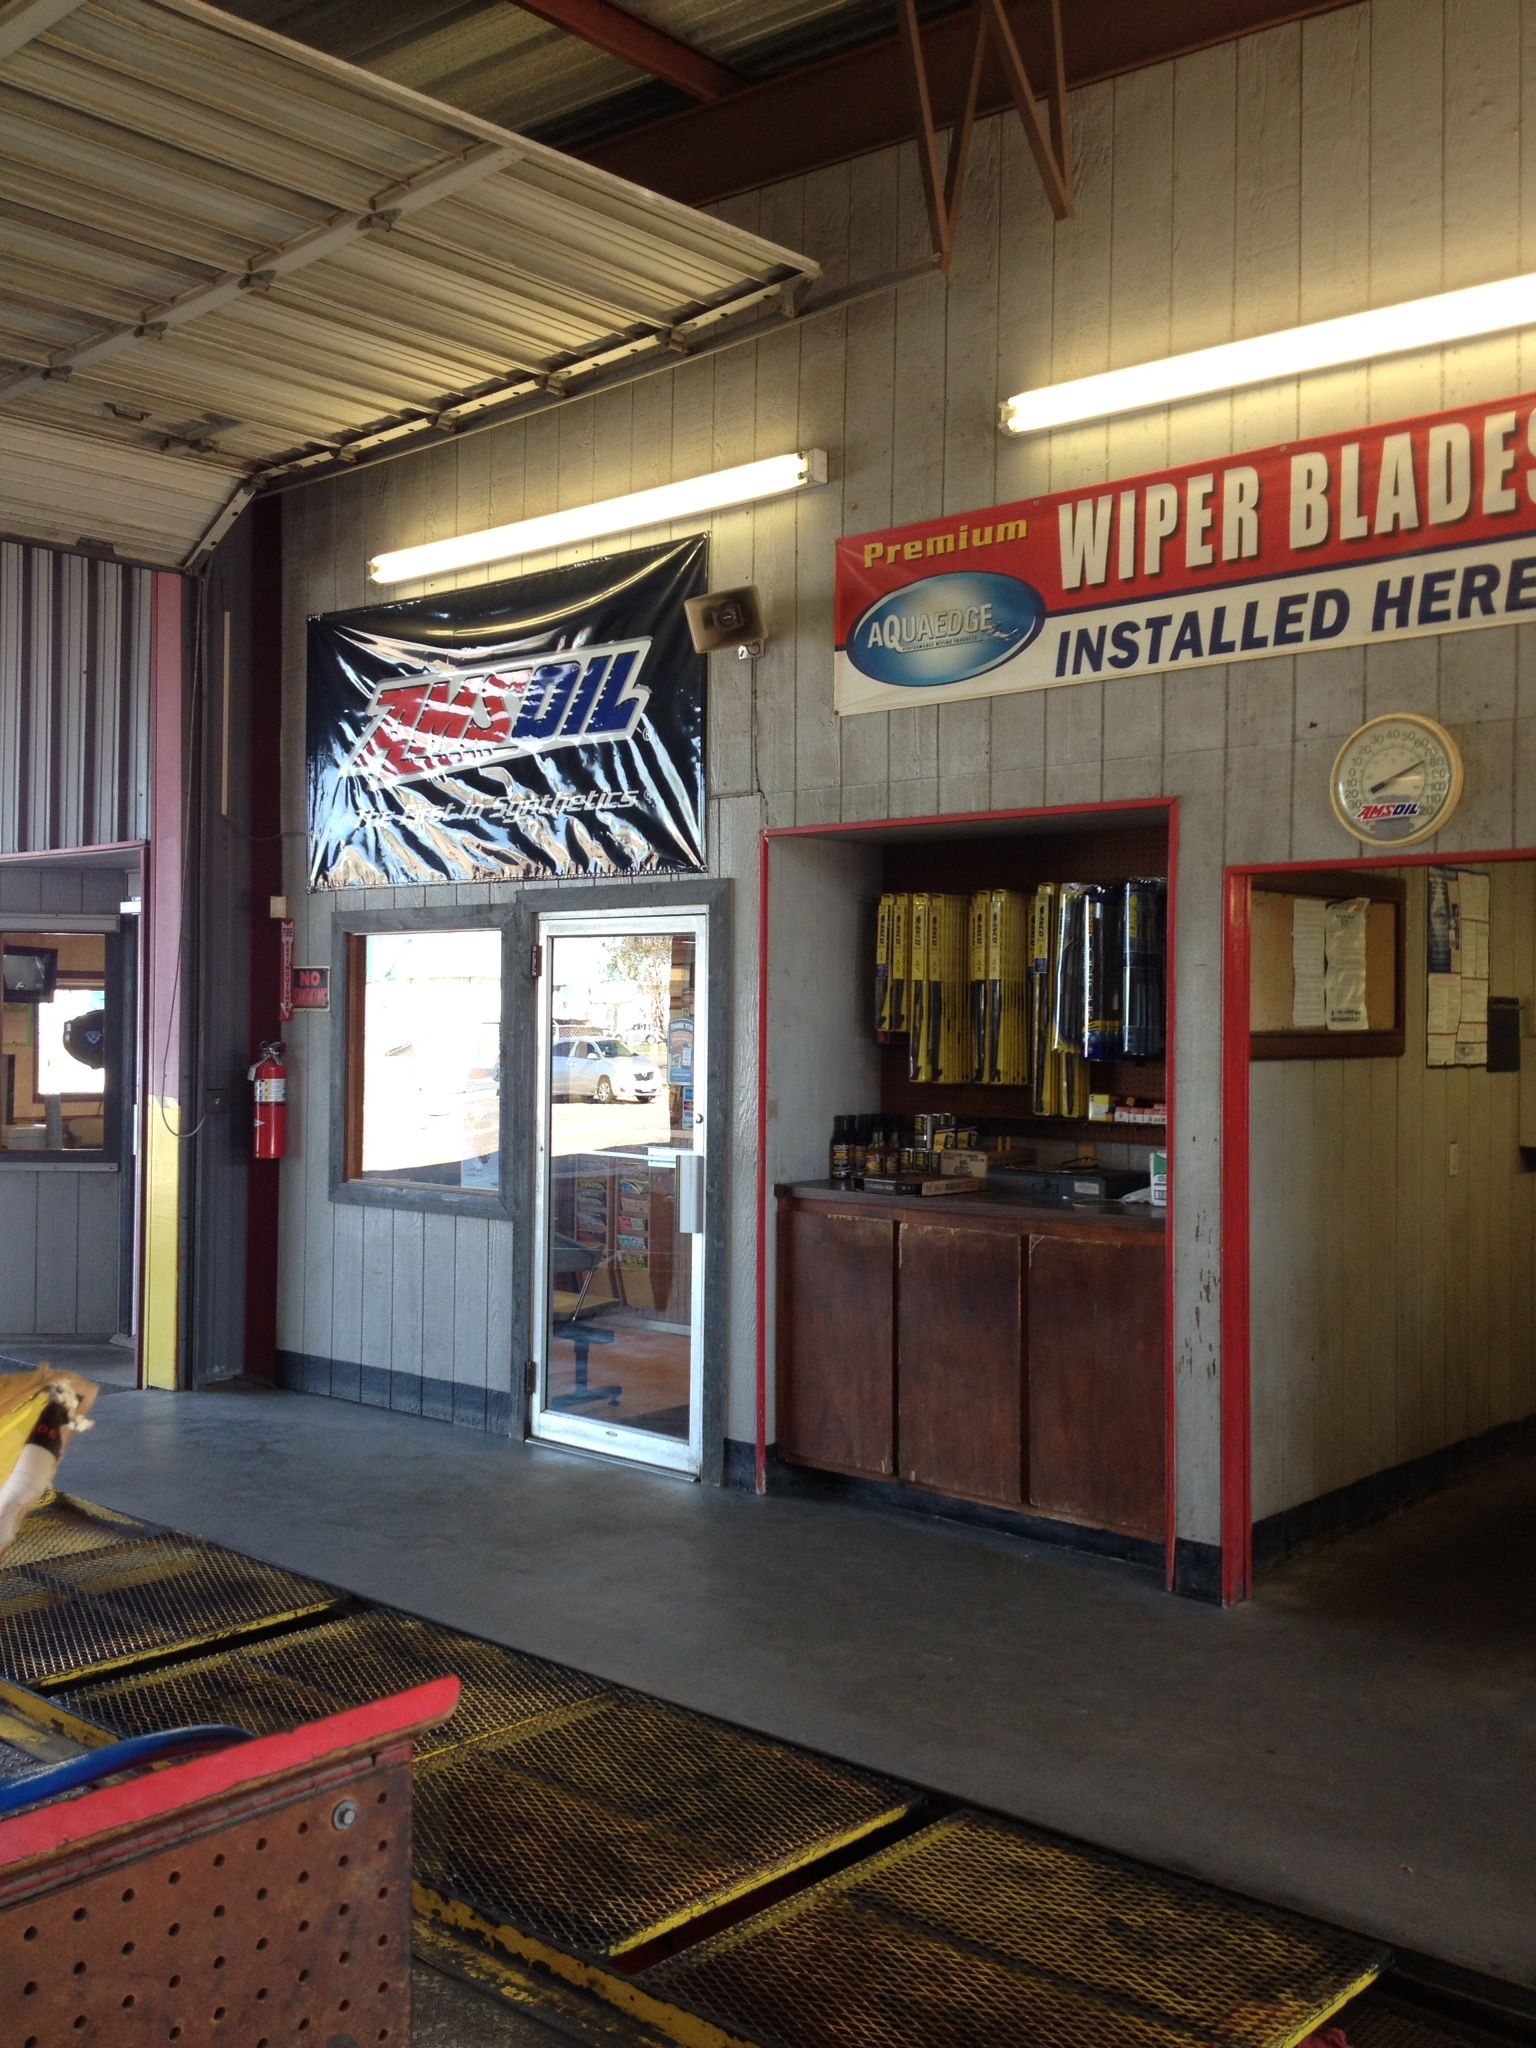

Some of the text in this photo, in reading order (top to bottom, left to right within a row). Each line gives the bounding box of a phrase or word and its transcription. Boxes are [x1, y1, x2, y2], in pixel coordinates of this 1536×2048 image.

[1058, 407, 1536, 590] WIPER BLADE
[863, 518, 1028, 569] Premium
[867, 603, 993, 652] AQUAEDGE
[1055, 556, 1536, 678] INSTALLED HERE
[350, 648, 642, 778] AMSOIL
[1386, 728, 1400, 740] 40
[489, 788, 640, 825] Synthetics
[1356, 803, 1420, 821] AMSOIL
[301, 971, 321, 987] NO
